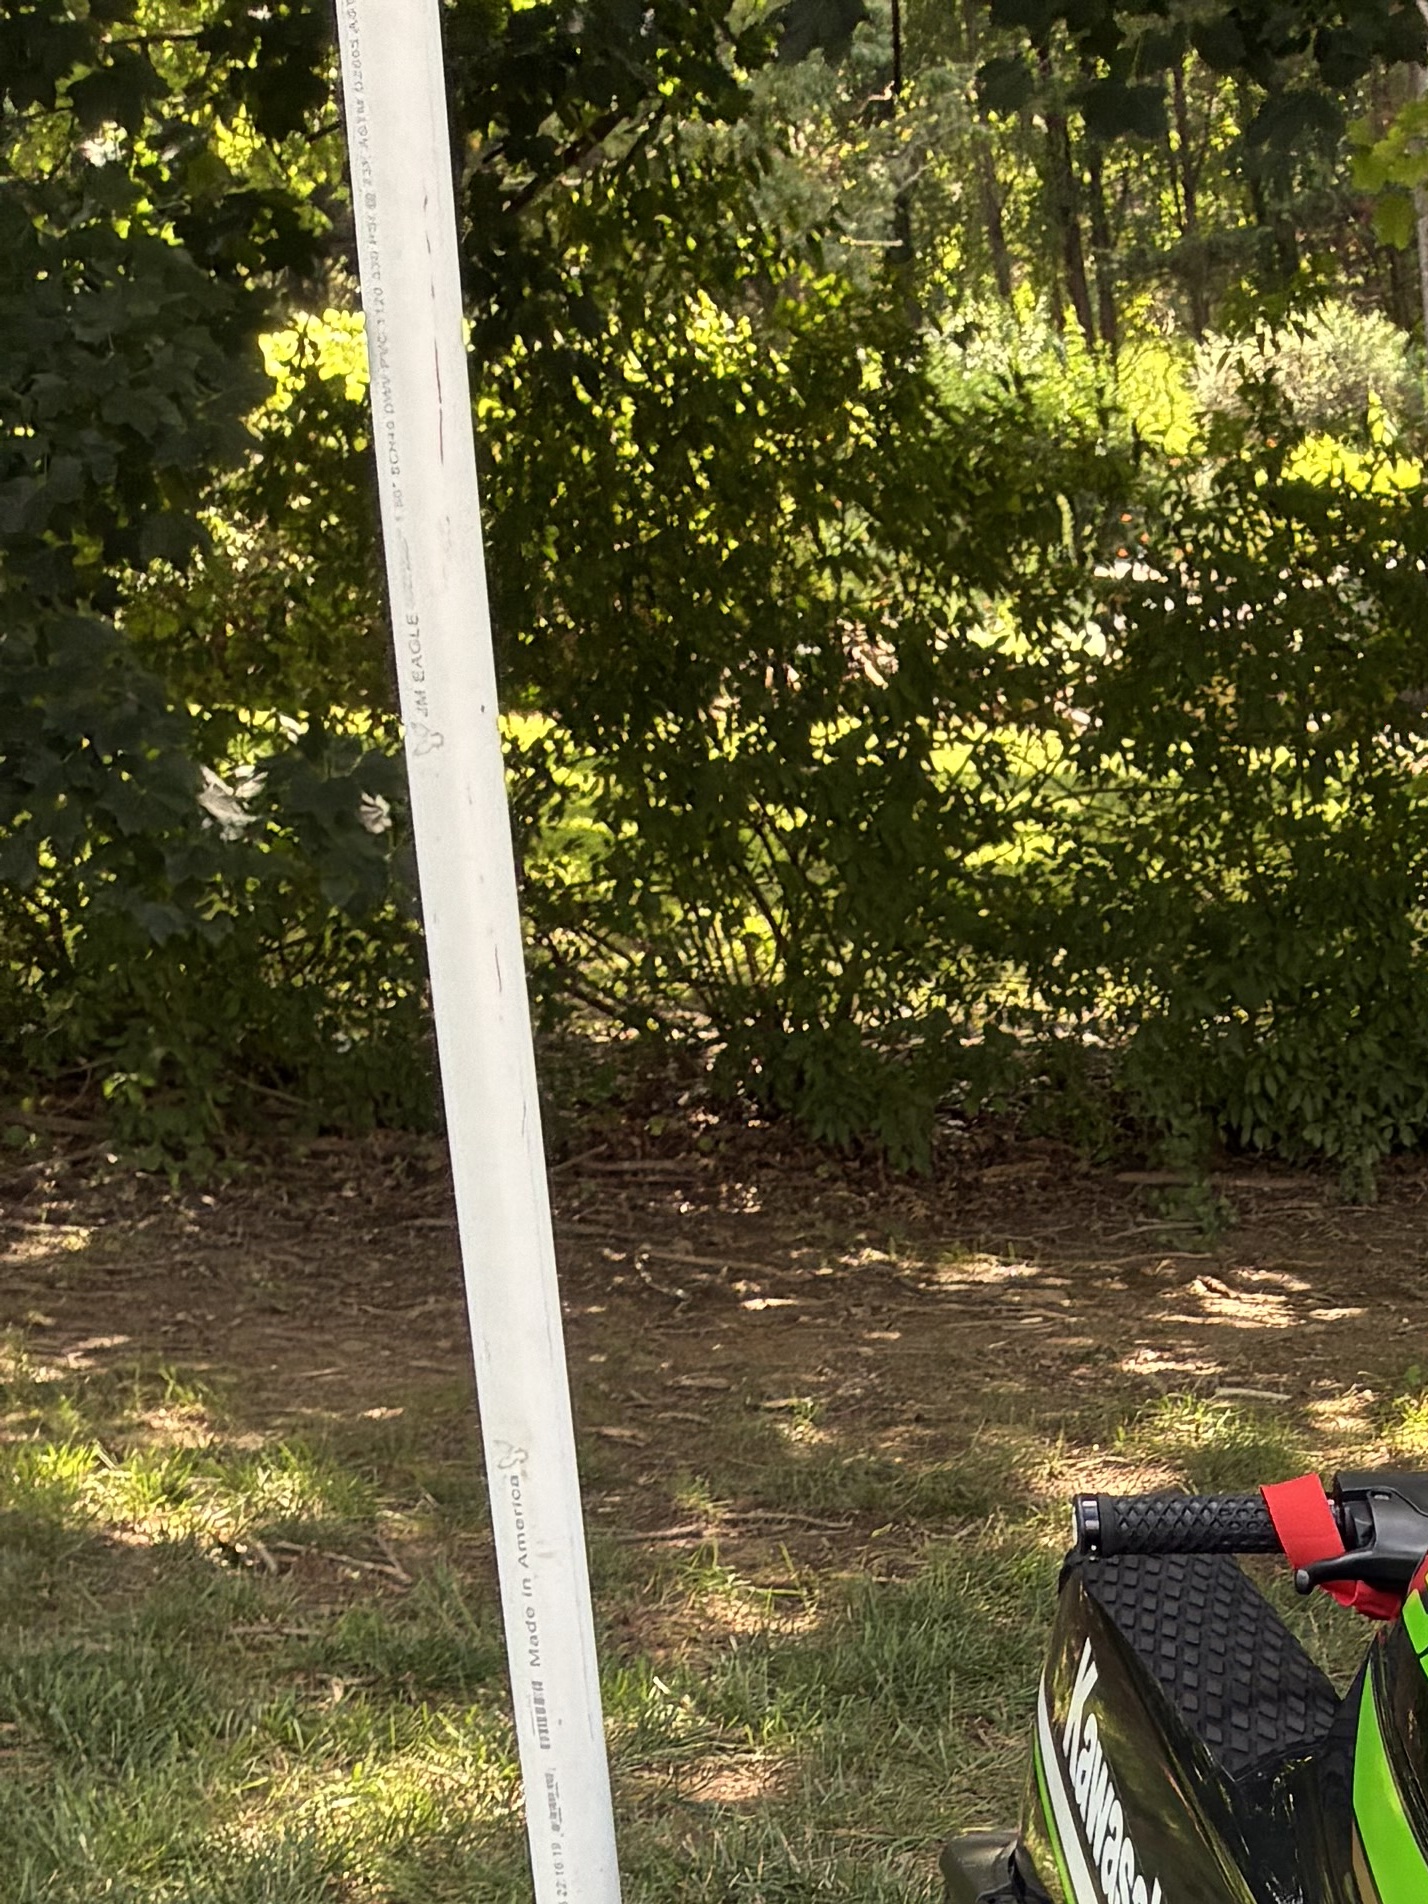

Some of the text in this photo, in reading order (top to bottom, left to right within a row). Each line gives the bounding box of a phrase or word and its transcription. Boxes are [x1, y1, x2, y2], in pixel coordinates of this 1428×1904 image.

[405, 613, 424, 682] EAGLE
[507, 1474, 529, 1569] America
[519, 1577, 532, 1598] in
[523, 1605, 541, 1667] Made
